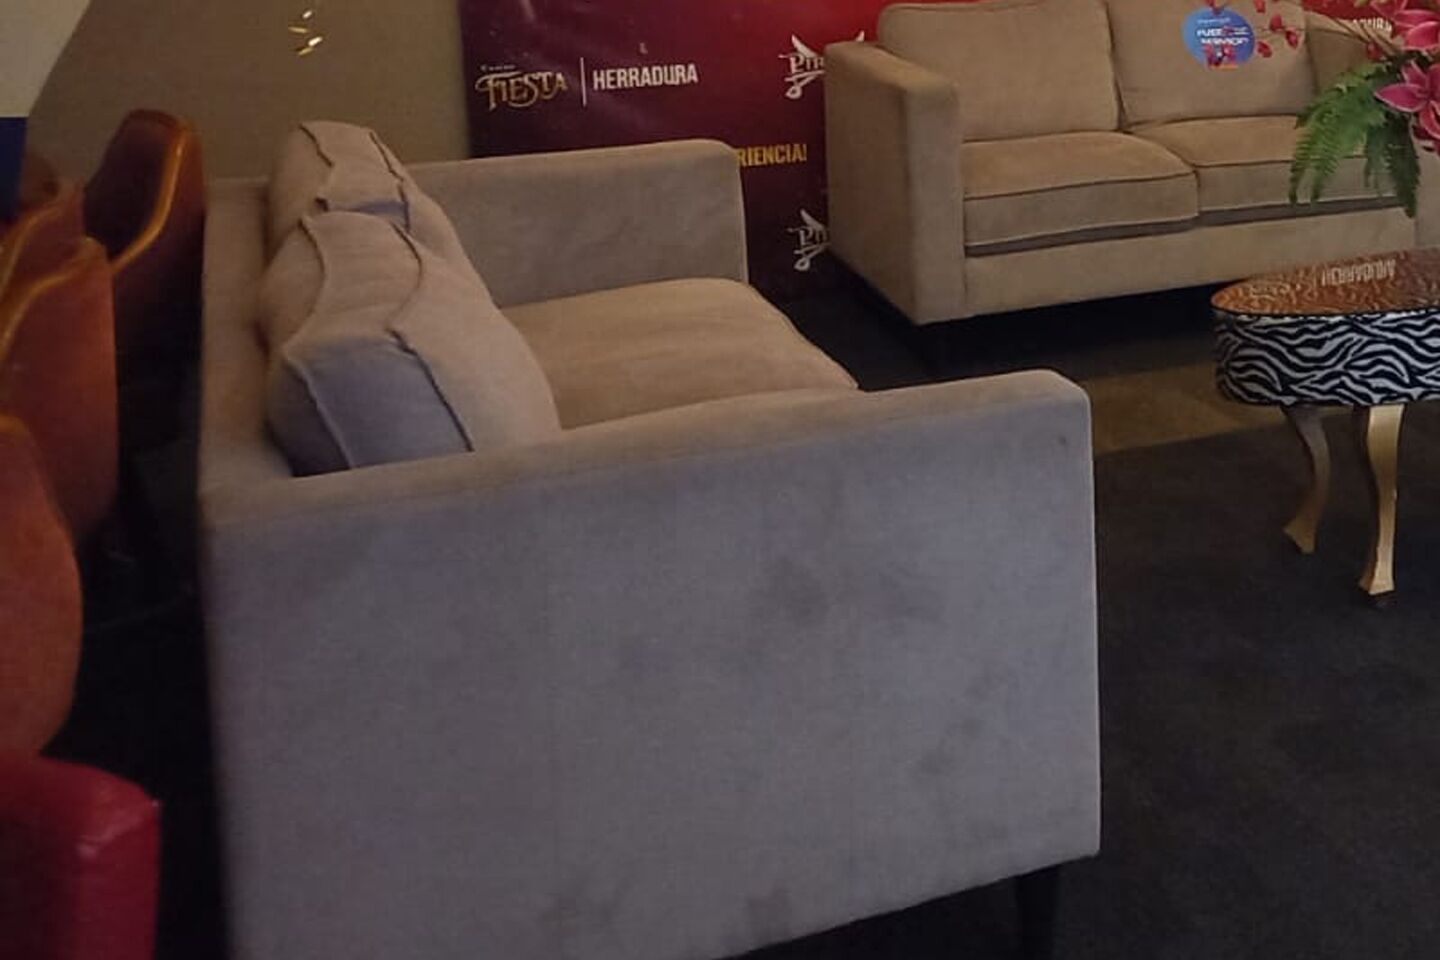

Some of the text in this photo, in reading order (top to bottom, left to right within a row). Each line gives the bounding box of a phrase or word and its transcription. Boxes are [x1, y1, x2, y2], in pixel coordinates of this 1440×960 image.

[475, 63, 698, 111] FIESTA HERRADURA
[736, 143, 807, 168] RIENCIA!
